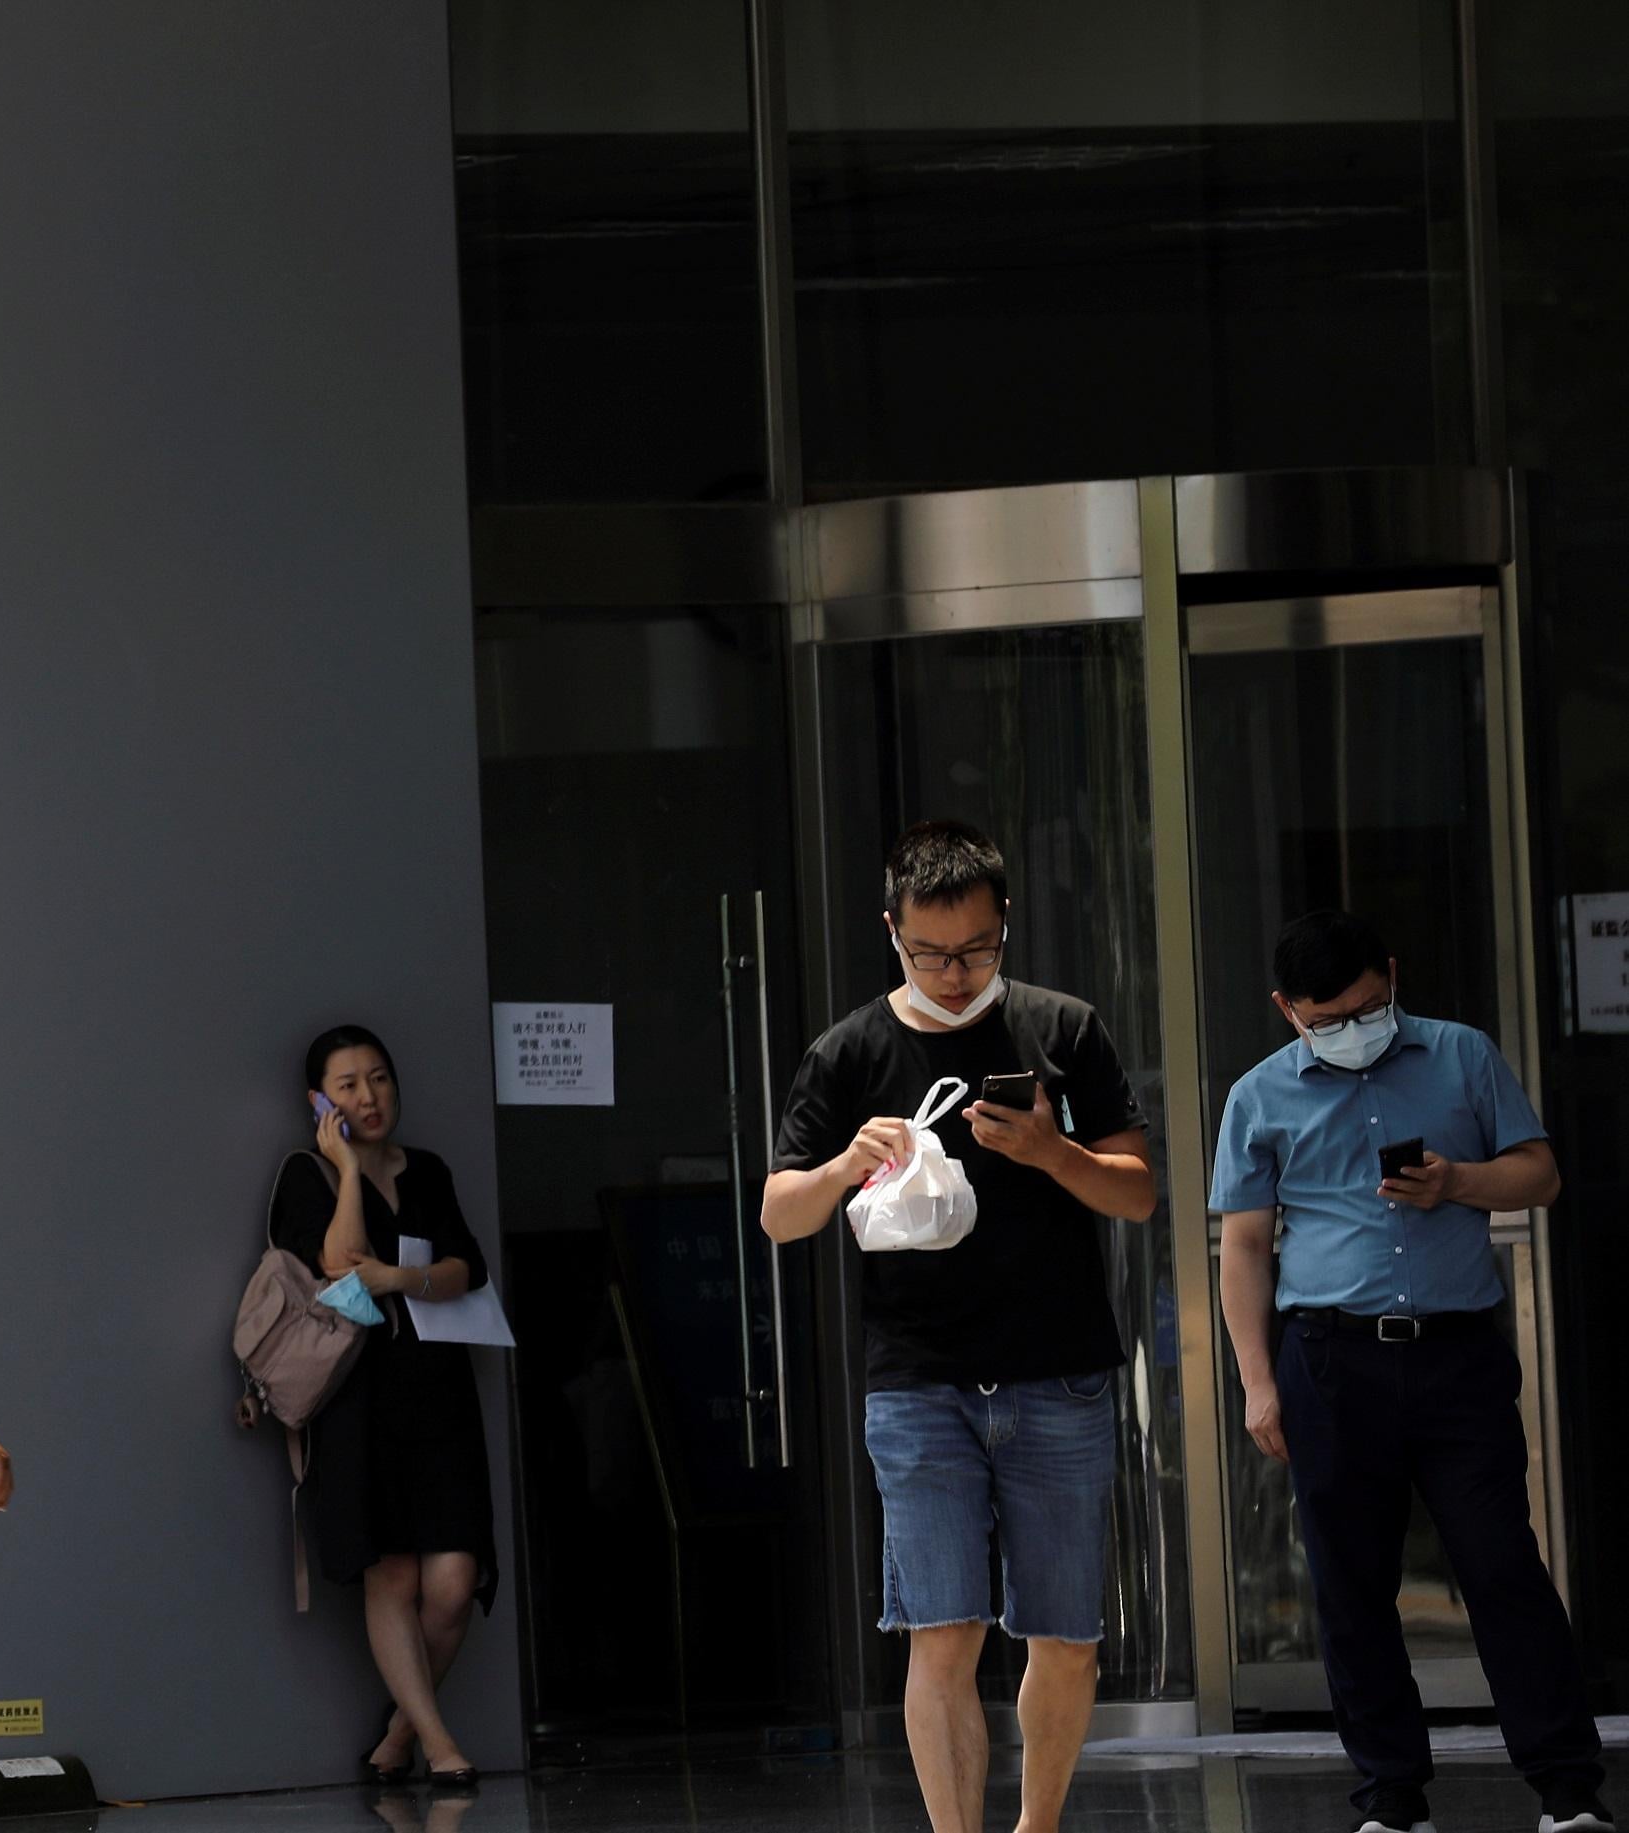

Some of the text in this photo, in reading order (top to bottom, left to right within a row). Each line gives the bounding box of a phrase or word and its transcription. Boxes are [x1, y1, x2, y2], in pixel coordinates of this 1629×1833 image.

[513, 1022, 586, 1034] 请不要对着人打
